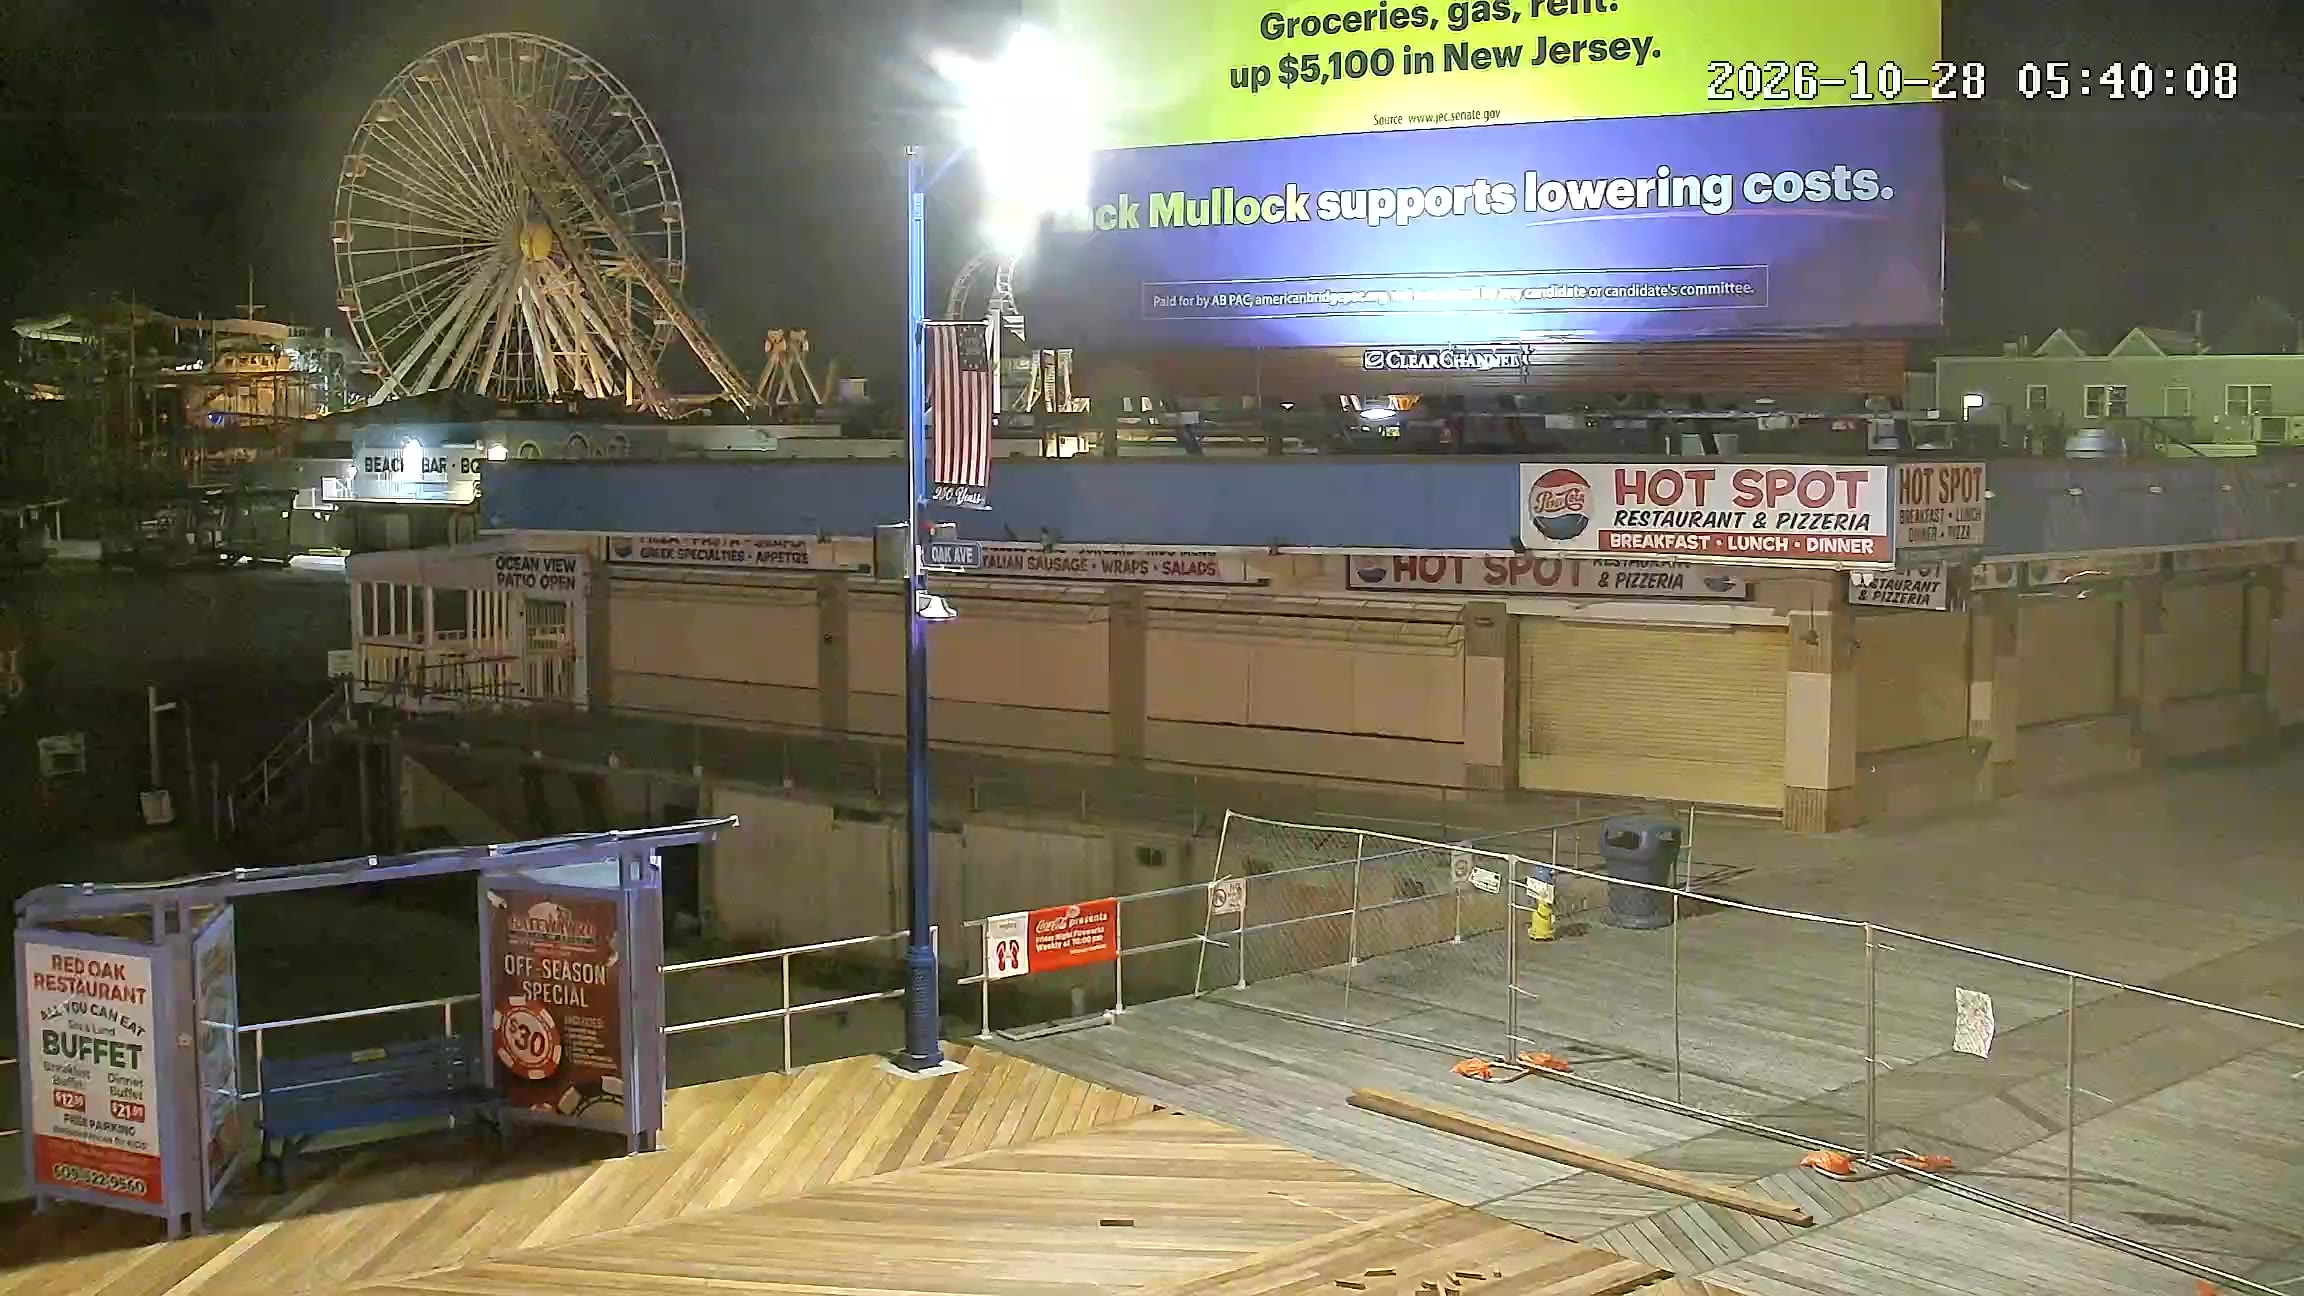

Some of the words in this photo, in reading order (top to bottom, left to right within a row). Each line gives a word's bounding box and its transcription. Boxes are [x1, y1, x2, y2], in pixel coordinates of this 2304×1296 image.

[1260, 0, 1438, 41] Groceries,
[1448, 0, 1522, 32] gas,
[1230, 62, 1271, 93] up
[1278, 47, 1395, 90] $5,100
[1402, 45, 1435, 76] in
[1443, 38, 1524, 72] New
[1530, 32, 1662, 69] Jersey.
[1149, 183, 1313, 229] Mullock
[1316, 179, 1517, 227] supports
[1524, 164, 1734, 216] lowering
[1742, 163, 1895, 205] costs.
[1153, 295, 1177, 308] Paid
[1178, 295, 1194, 307] for
[1196, 296, 1210, 309] by
[1212, 295, 1227, 307] AB
[1588, 285, 1603, 298] or
[1604, 281, 1678, 298] candidate's
[1679, 282, 1755, 296] committee.
[421, 456, 448, 474] BAR
[1614, 468, 1716, 508] HOT
[1733, 468, 1871, 510] SPOT
[1900, 468, 1934, 505] HOT
[1938, 466, 1983, 504] SPOT
[1614, 509, 1744, 530] RESTAURANT
[1752, 510, 1768, 530] &
[1776, 510, 1871, 531] PIZZERIA
[931, 546, 952, 563] OAK
[953, 546, 974, 563] AVE
[1609, 532, 1710, 552] BREAKFAST
[1727, 535, 1788, 552] LUNCH
[1806, 537, 1874, 556] DINNER
[496, 555, 540, 573] OCEAN
[543, 559, 577, 573] VIEW
[982, 555, 1024, 571] TALIAN
[1027, 554, 1088, 573] SAUSAGE
[1102, 558, 1149, 576] WRAPS
[1393, 556, 1473, 585] HOT
[497, 573, 536, 589] PATIO
[539, 574, 576, 590] OPEN
[1597, 571, 1610, 588] &
[1615, 572, 1684, 590] PIZZERIA
[1872, 591, 1931, 605] PIZZERIA
[52, 955, 84, 974] RED
[88, 960, 126, 981] OAK
[33, 972, 147, 1005] RESTAURANT
[522, 980, 589, 1008] SPECIAL
[90, 1003, 118, 1022] CAN
[119, 1015, 146, 1037] EAT
[42, 1029, 143, 1070] BUFFET
